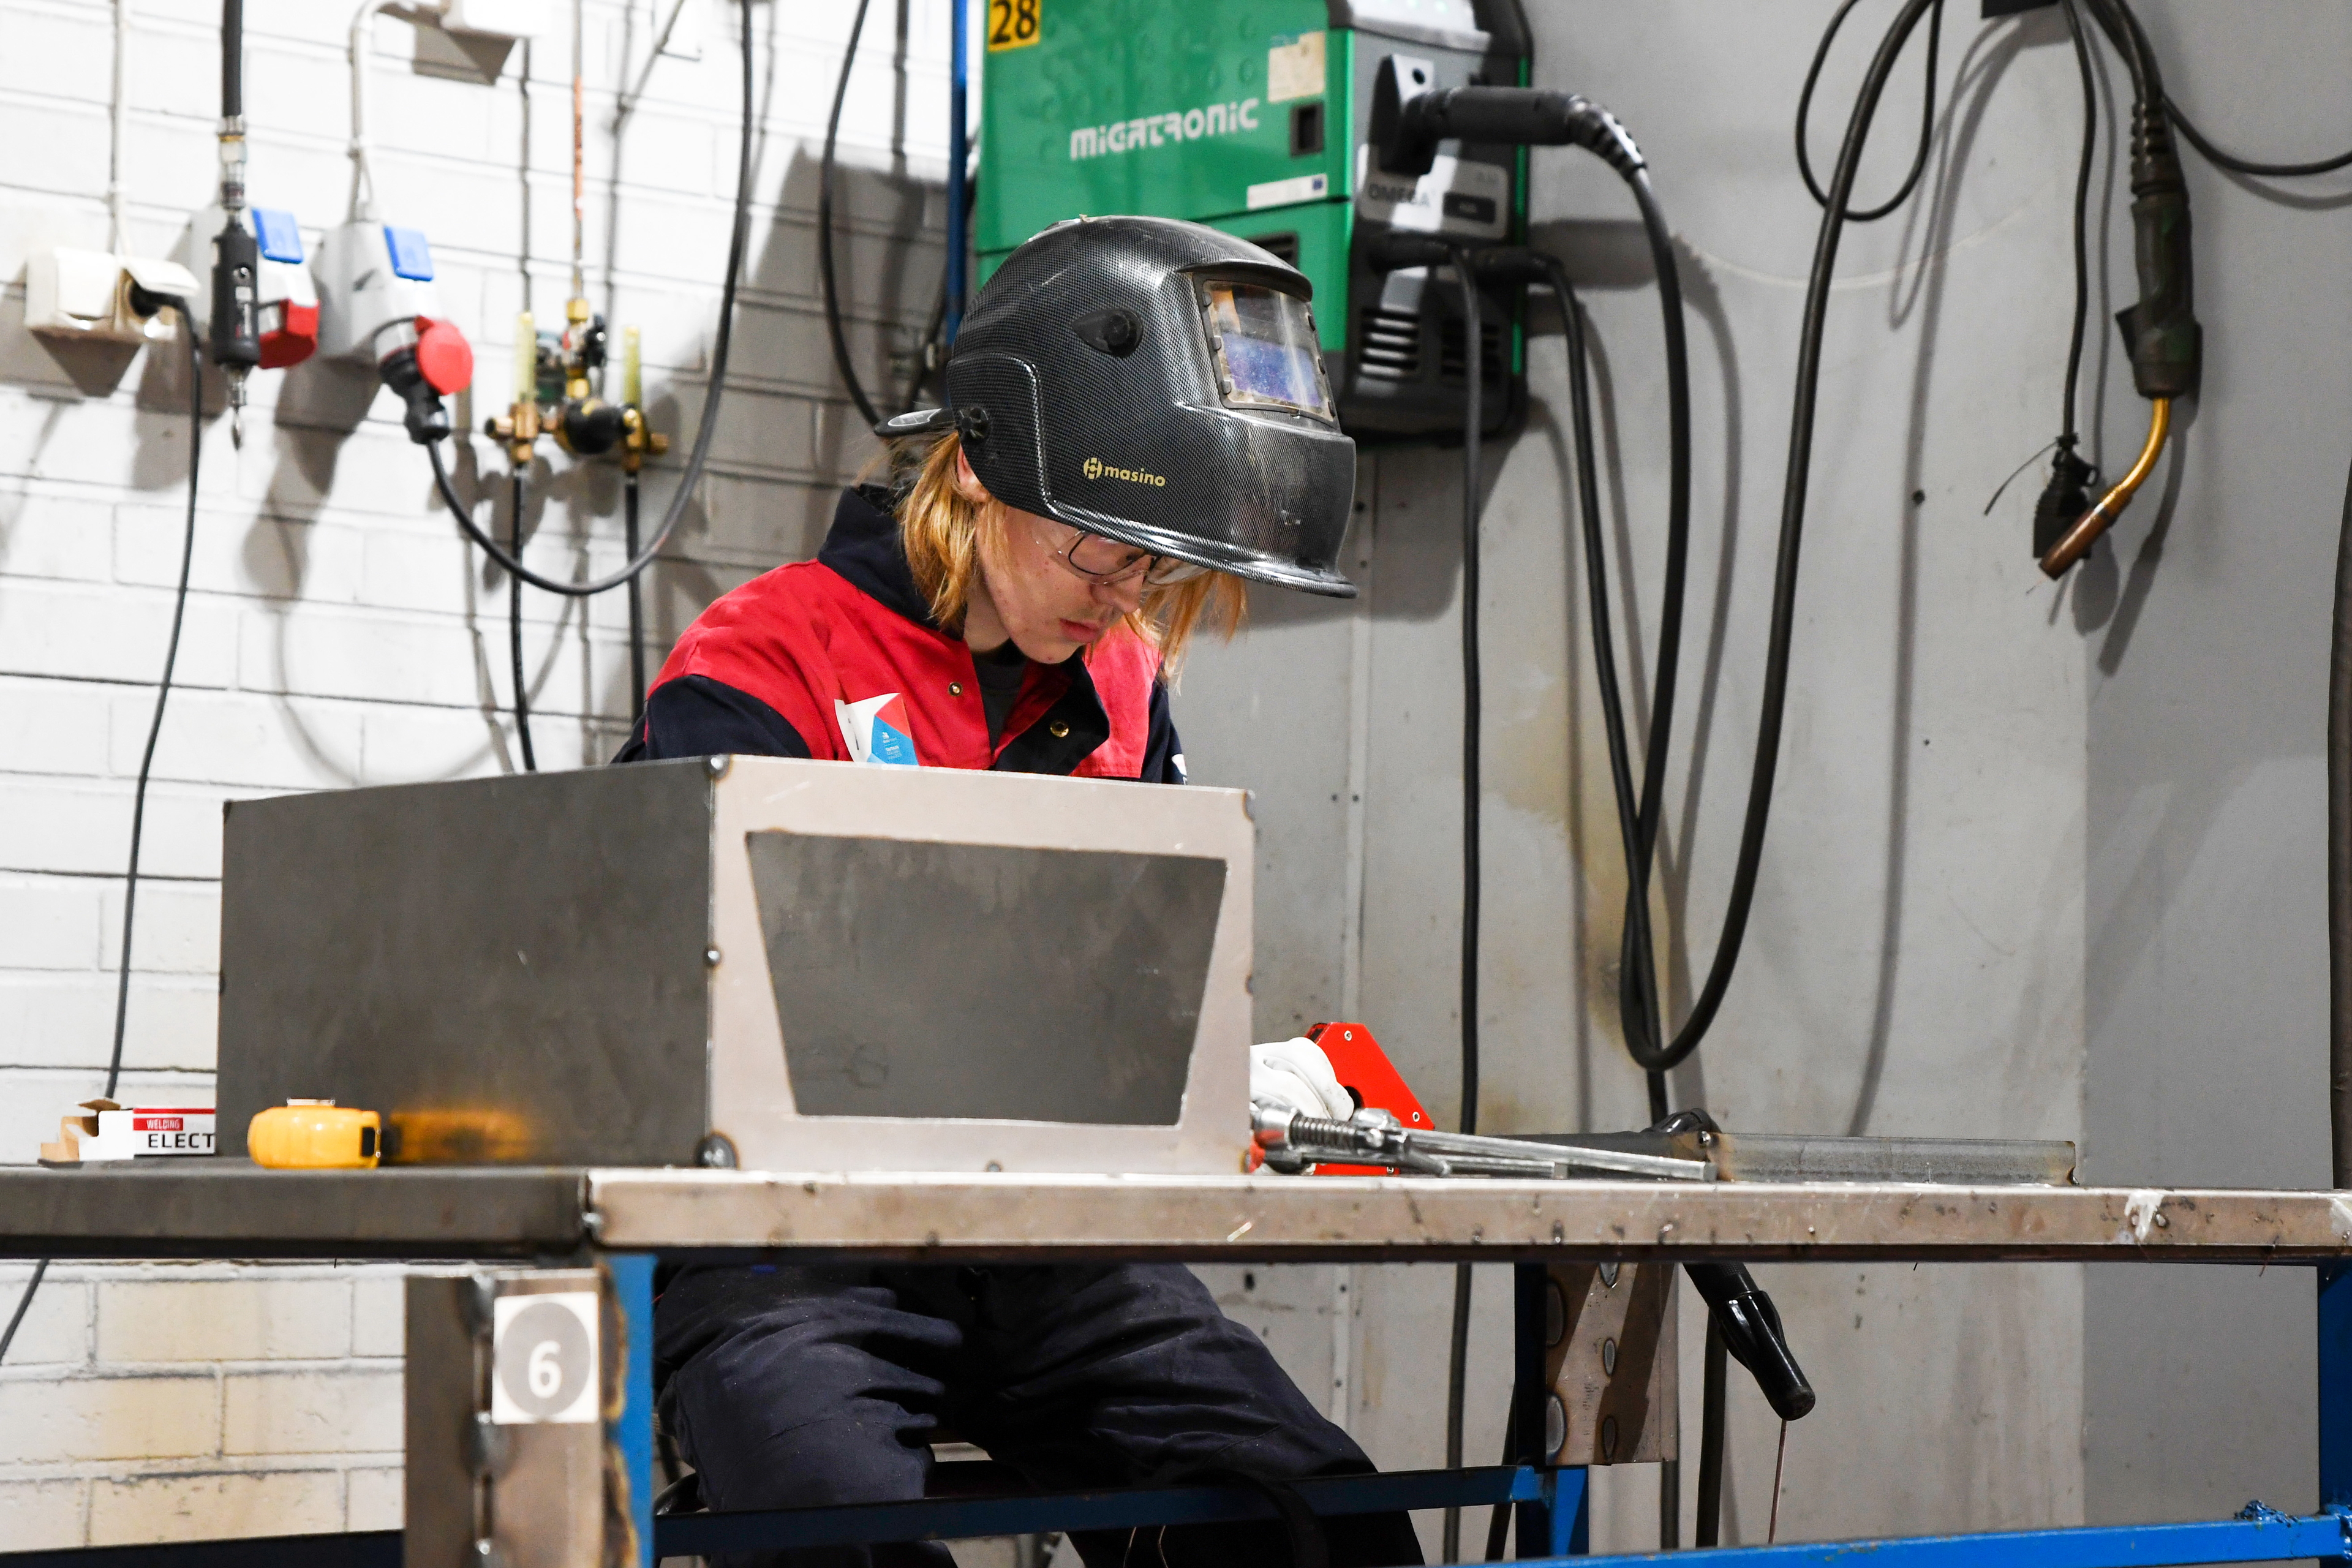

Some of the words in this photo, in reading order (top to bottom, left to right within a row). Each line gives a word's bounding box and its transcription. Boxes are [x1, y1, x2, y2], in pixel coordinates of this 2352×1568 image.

[992, 0, 1036, 44] 28
[1104, 466, 1166, 487] masino
[146, 1118, 180, 1129] WELDING
[148, 1133, 214, 1148] ELECT
[529, 1340, 563, 1399] 6
